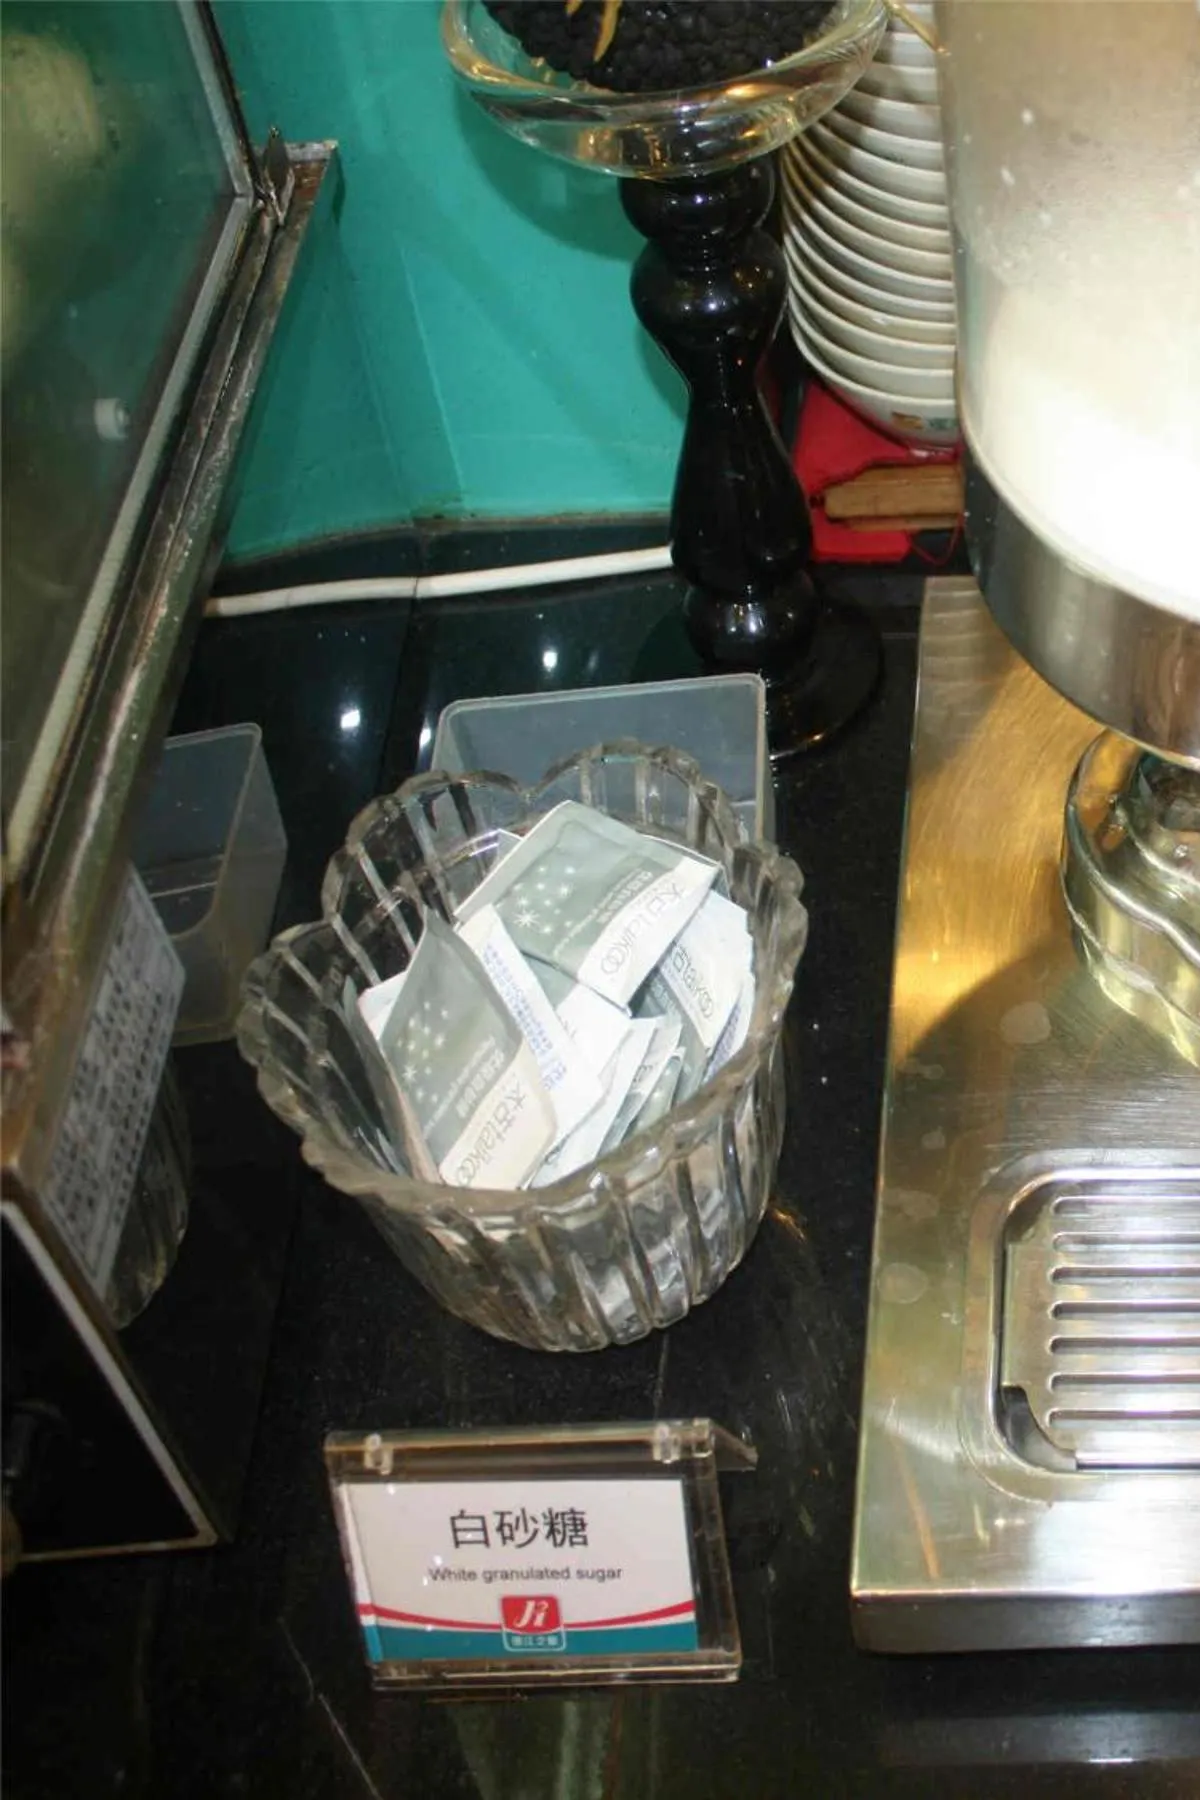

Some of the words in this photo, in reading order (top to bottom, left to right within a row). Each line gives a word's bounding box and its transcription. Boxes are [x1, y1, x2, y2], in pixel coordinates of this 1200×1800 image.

[450, 1507, 589, 1549] 白砂糖
[429, 1567, 477, 1582] White
[482, 1566, 570, 1584] granulated
[576, 1567, 622, 1582] sugar
